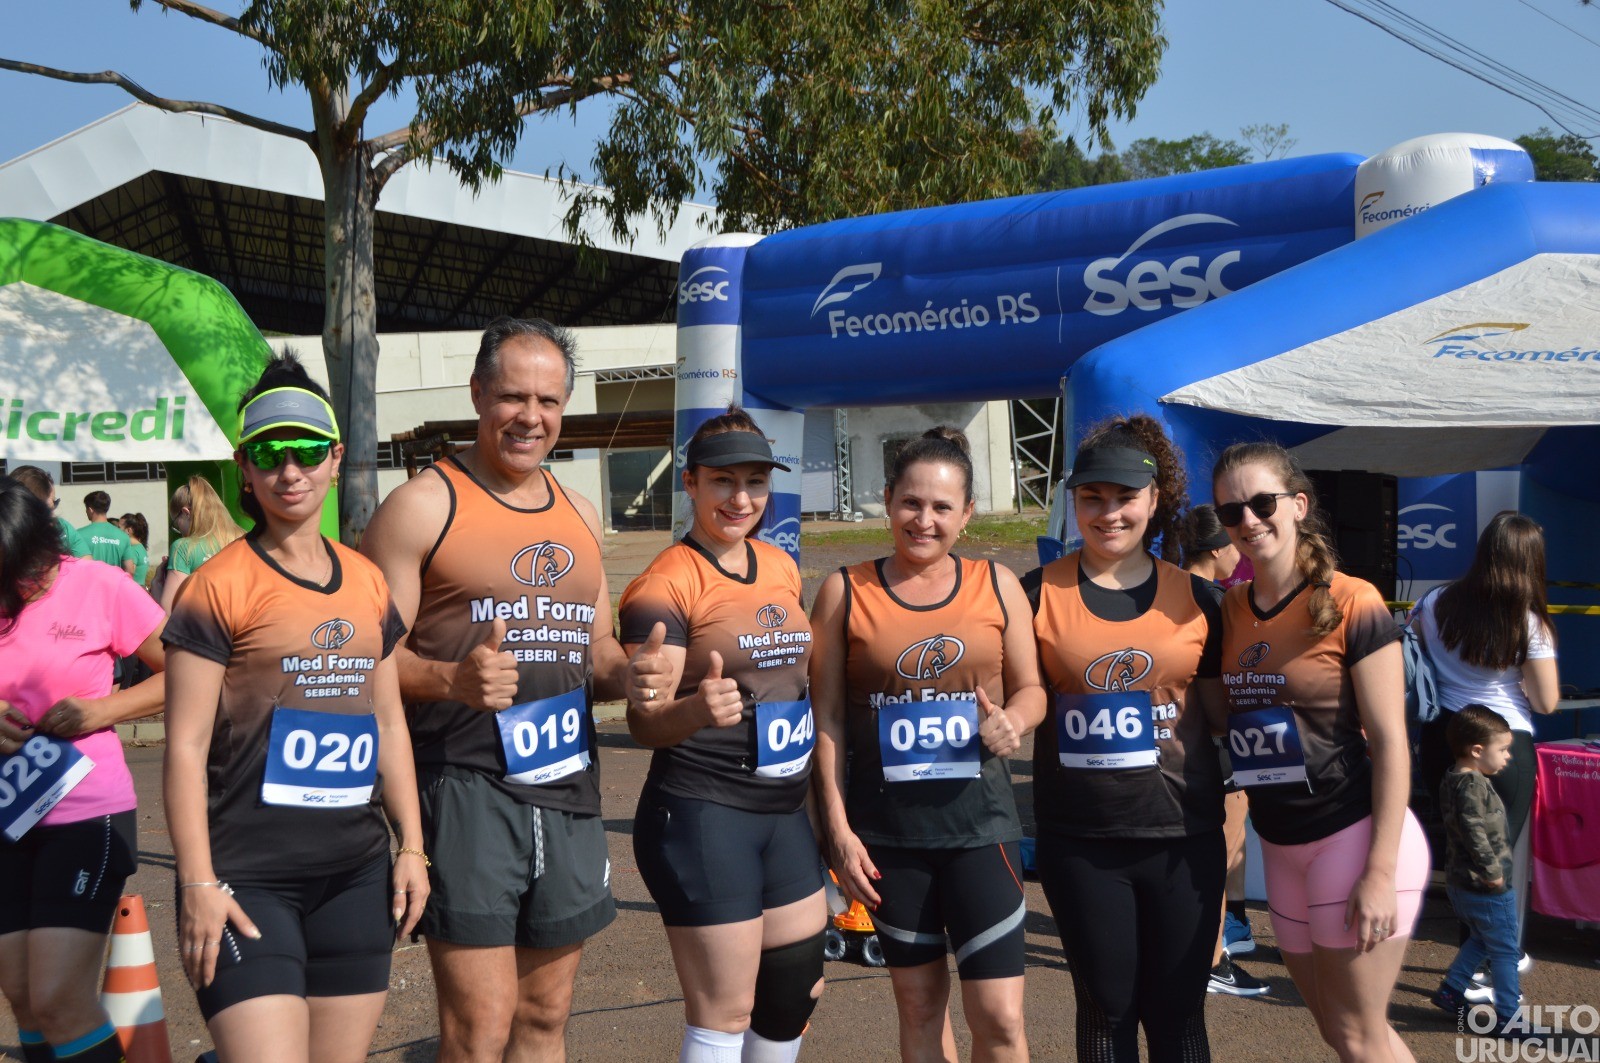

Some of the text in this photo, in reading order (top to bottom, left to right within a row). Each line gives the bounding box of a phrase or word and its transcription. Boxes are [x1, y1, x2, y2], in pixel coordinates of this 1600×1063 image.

[828, 292, 1040, 338] Fecomércio RS
[722, 368, 738, 379] RS
[0, 396, 187, 442] icredi
[1397, 523, 1457, 550] esc
[470, 595, 529, 623] Med
[502, 625, 590, 646] cademia
[738, 630, 812, 650] Med Forma
[514, 648, 557, 664] EBERI
[568, 650, 582, 665] RS
[751, 645, 805, 660] Academia
[757, 658, 782, 669] SEBERI
[788, 657, 797, 665] RS
[281, 653, 375, 674] Med Forma
[295, 672, 366, 686] Academia
[1222, 671, 1286, 686] Med Forma
[305, 687, 341, 698] SEBERI
[348, 687, 360, 697] RS
[920, 687, 977, 703] Form
[1229, 686, 1277, 696] Academia
[1235, 698, 1258, 706] SEBERI
[1262, 698, 1272, 706] RS
[513, 708, 580, 758] 019
[768, 707, 814, 752] 040
[890, 715, 971, 751] 050
[1065, 706, 1142, 740] 046
[1229, 721, 1288, 758] 027
[283, 729, 374, 772] 020
